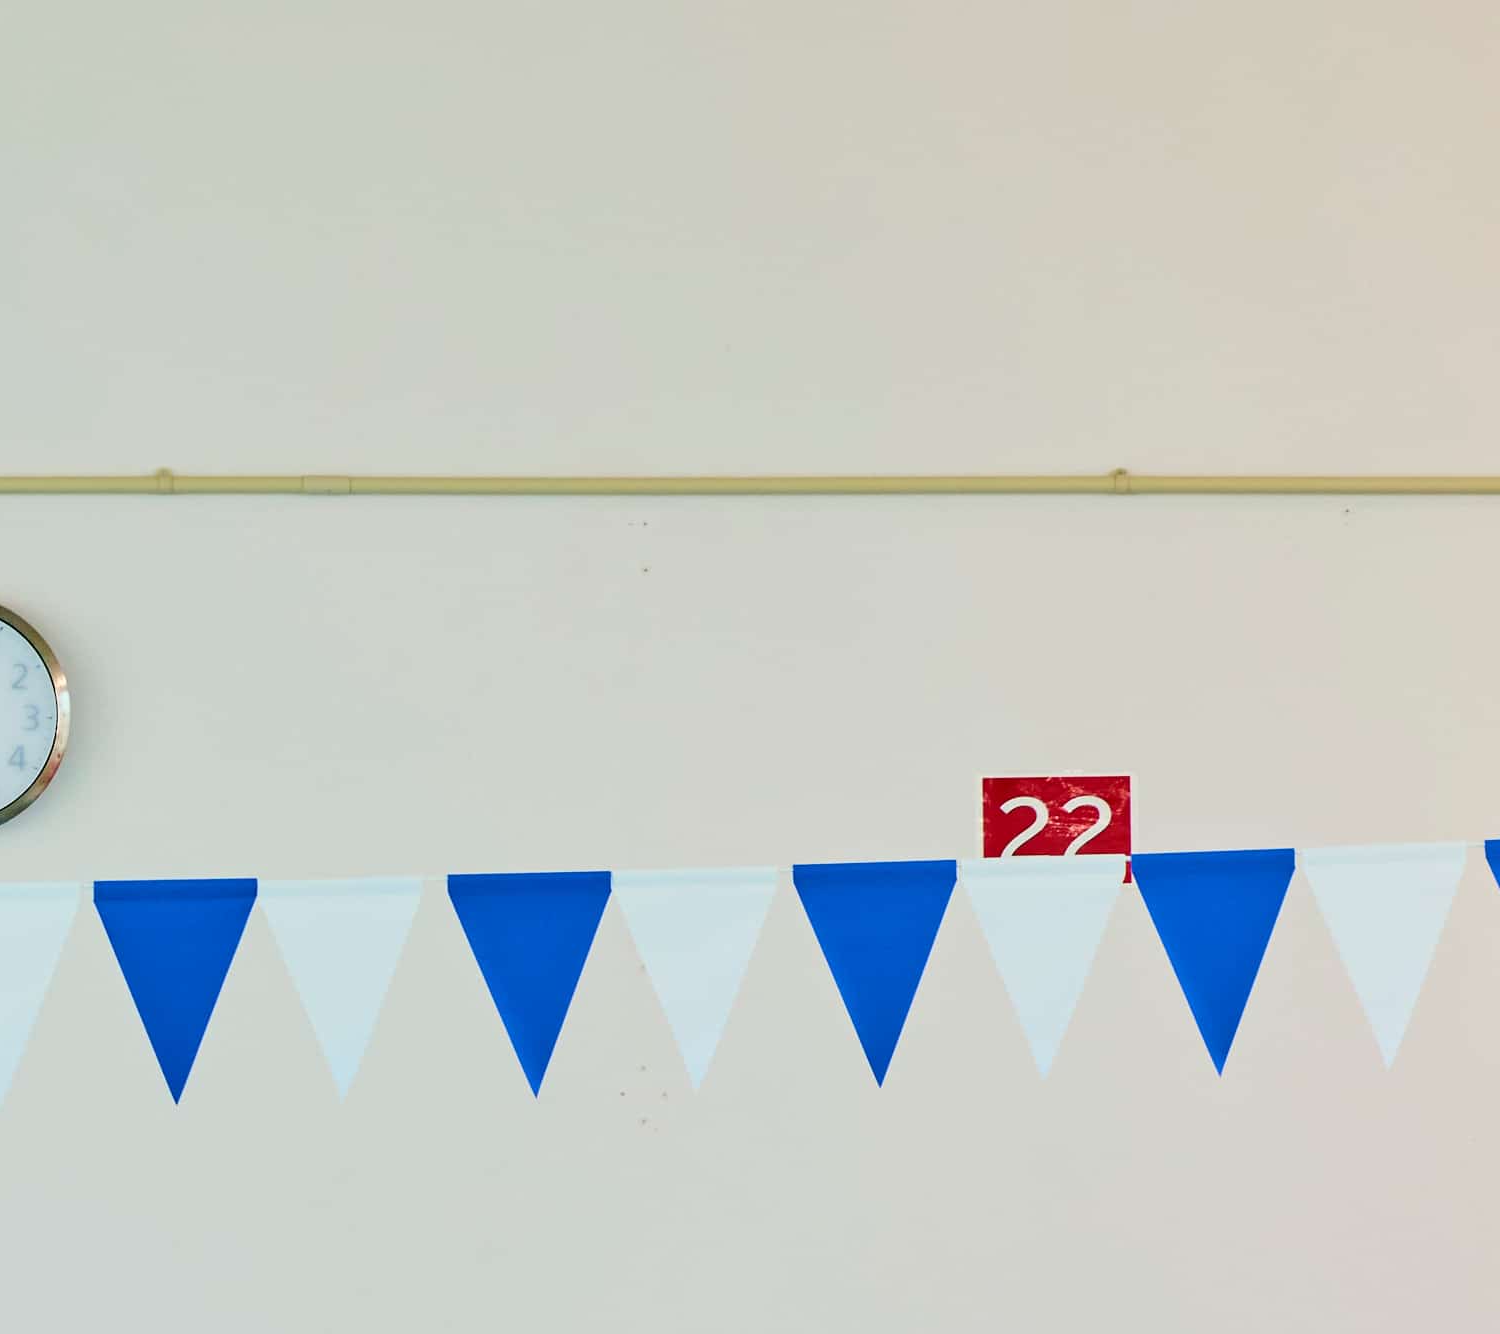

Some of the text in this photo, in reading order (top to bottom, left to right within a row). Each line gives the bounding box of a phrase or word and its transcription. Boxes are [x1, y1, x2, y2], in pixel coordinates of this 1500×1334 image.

[11, 663, 29, 690] 2
[22, 704, 40, 732] 3
[8, 744, 26, 771] 4
[1000, 795, 1113, 856] 22
